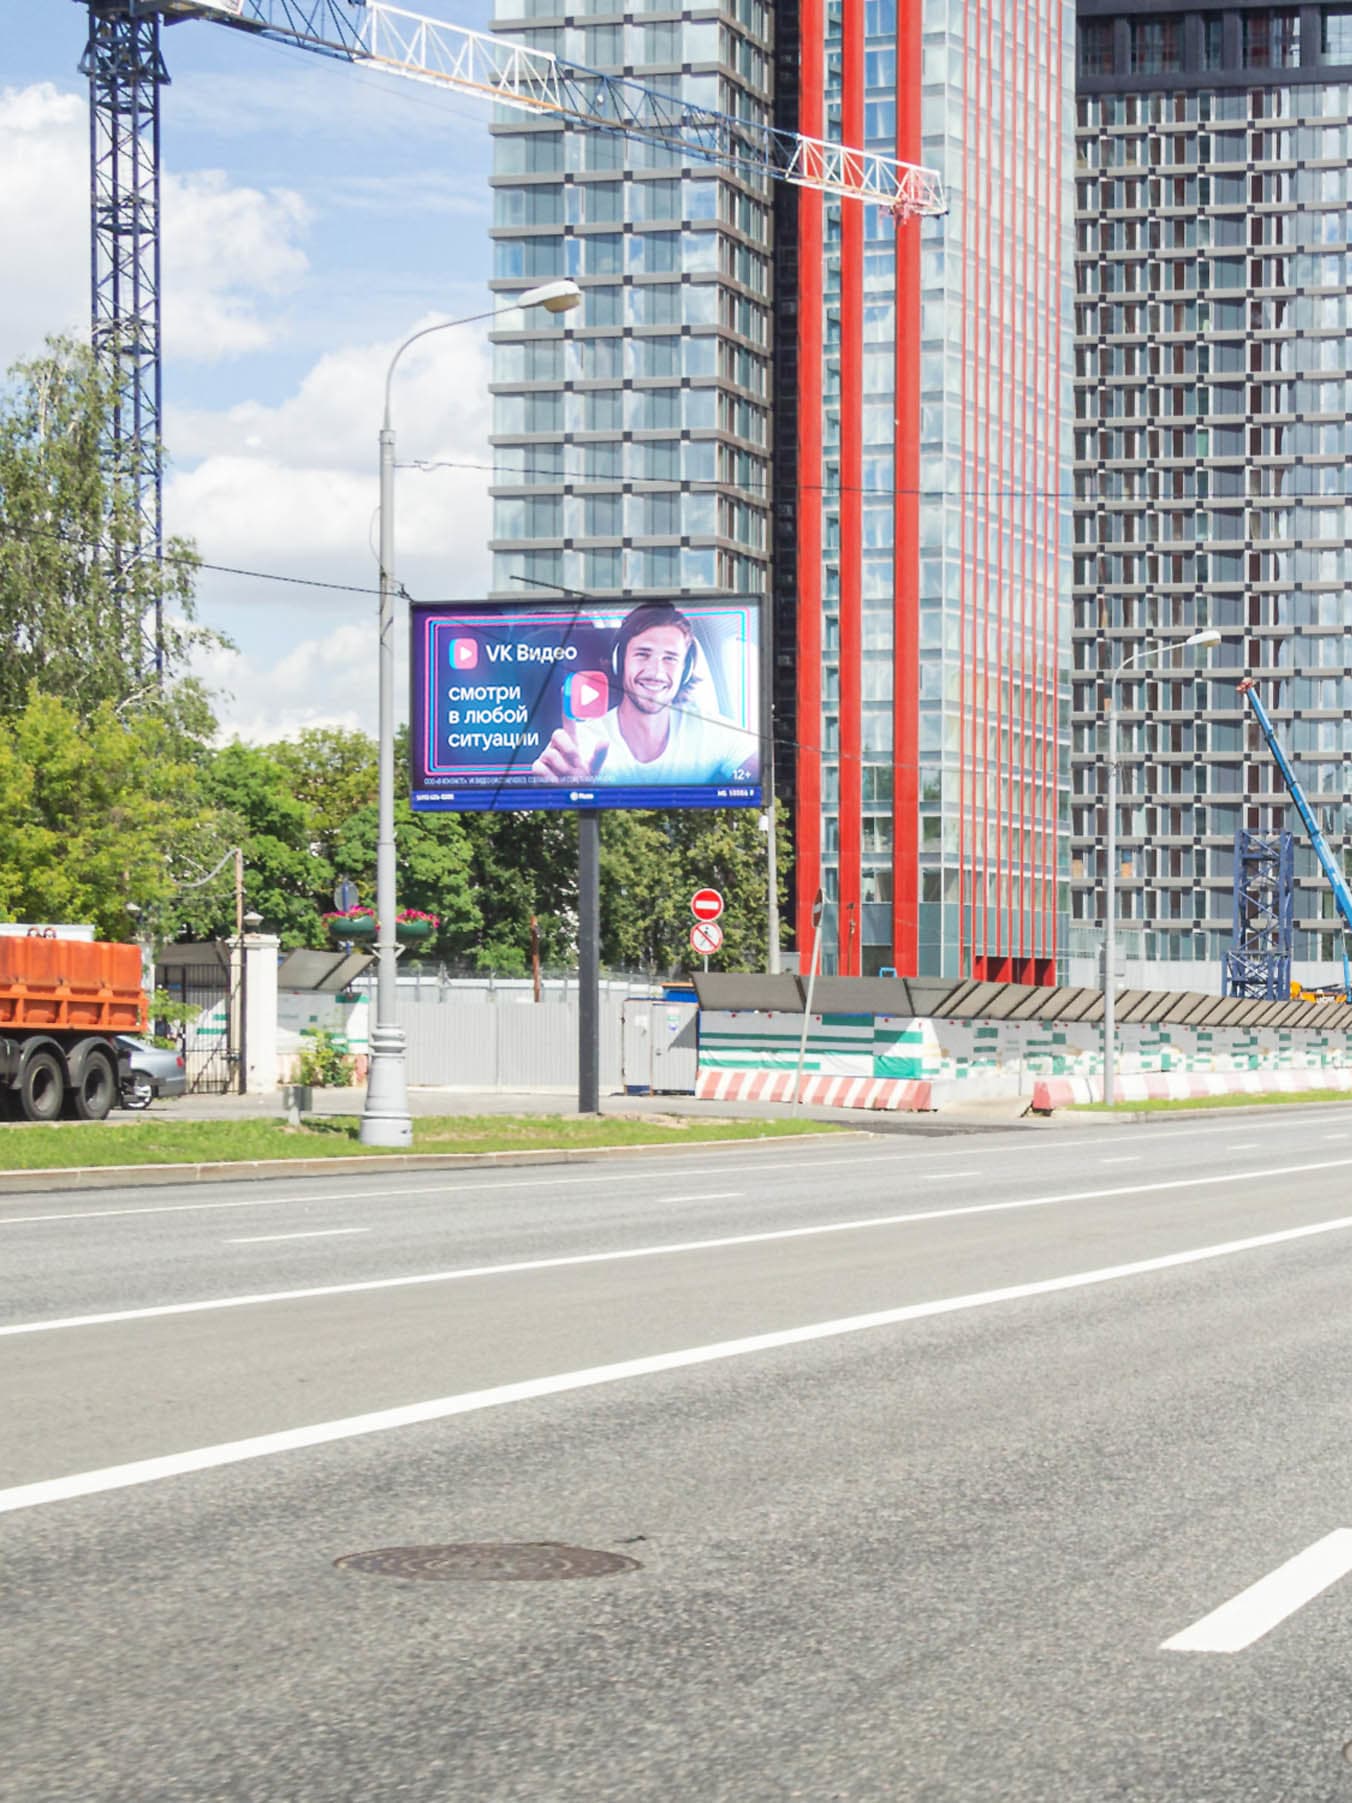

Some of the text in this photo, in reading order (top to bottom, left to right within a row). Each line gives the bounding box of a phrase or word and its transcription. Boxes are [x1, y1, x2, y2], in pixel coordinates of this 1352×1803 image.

[486, 643, 578, 664] VK Видео
[448, 686, 521, 704] смотри
[448, 705, 528, 724] в любой
[447, 732, 540, 751] ситуации
[732, 769, 752, 781] 12+
